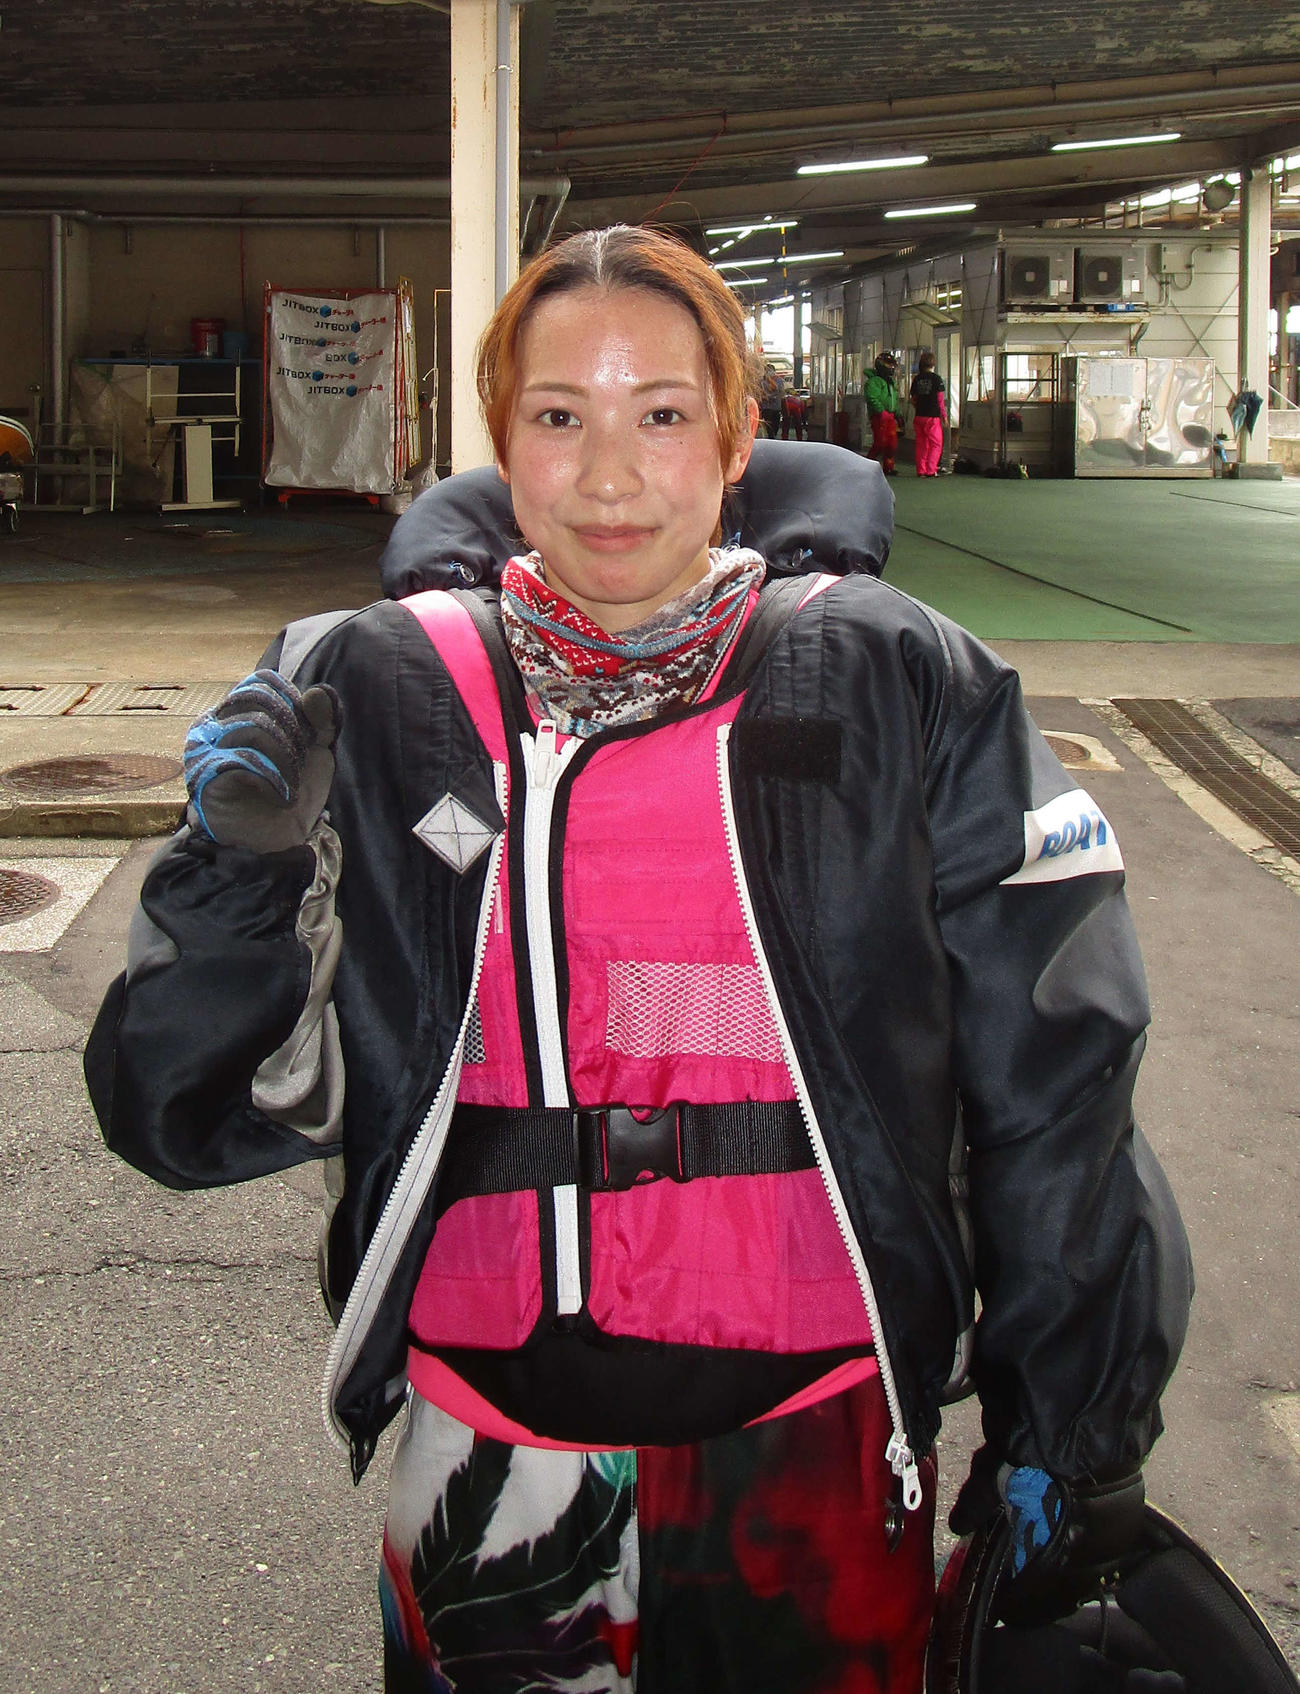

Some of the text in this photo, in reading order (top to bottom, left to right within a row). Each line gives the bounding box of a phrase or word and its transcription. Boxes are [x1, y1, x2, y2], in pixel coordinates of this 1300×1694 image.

[282, 299, 319, 314] JITBOX
[314, 321, 351, 332] JITBOX
[279, 333, 316, 346] JITBOX
[276, 367, 311, 379] JITBOX
[308, 386, 345, 394] JITBOX
